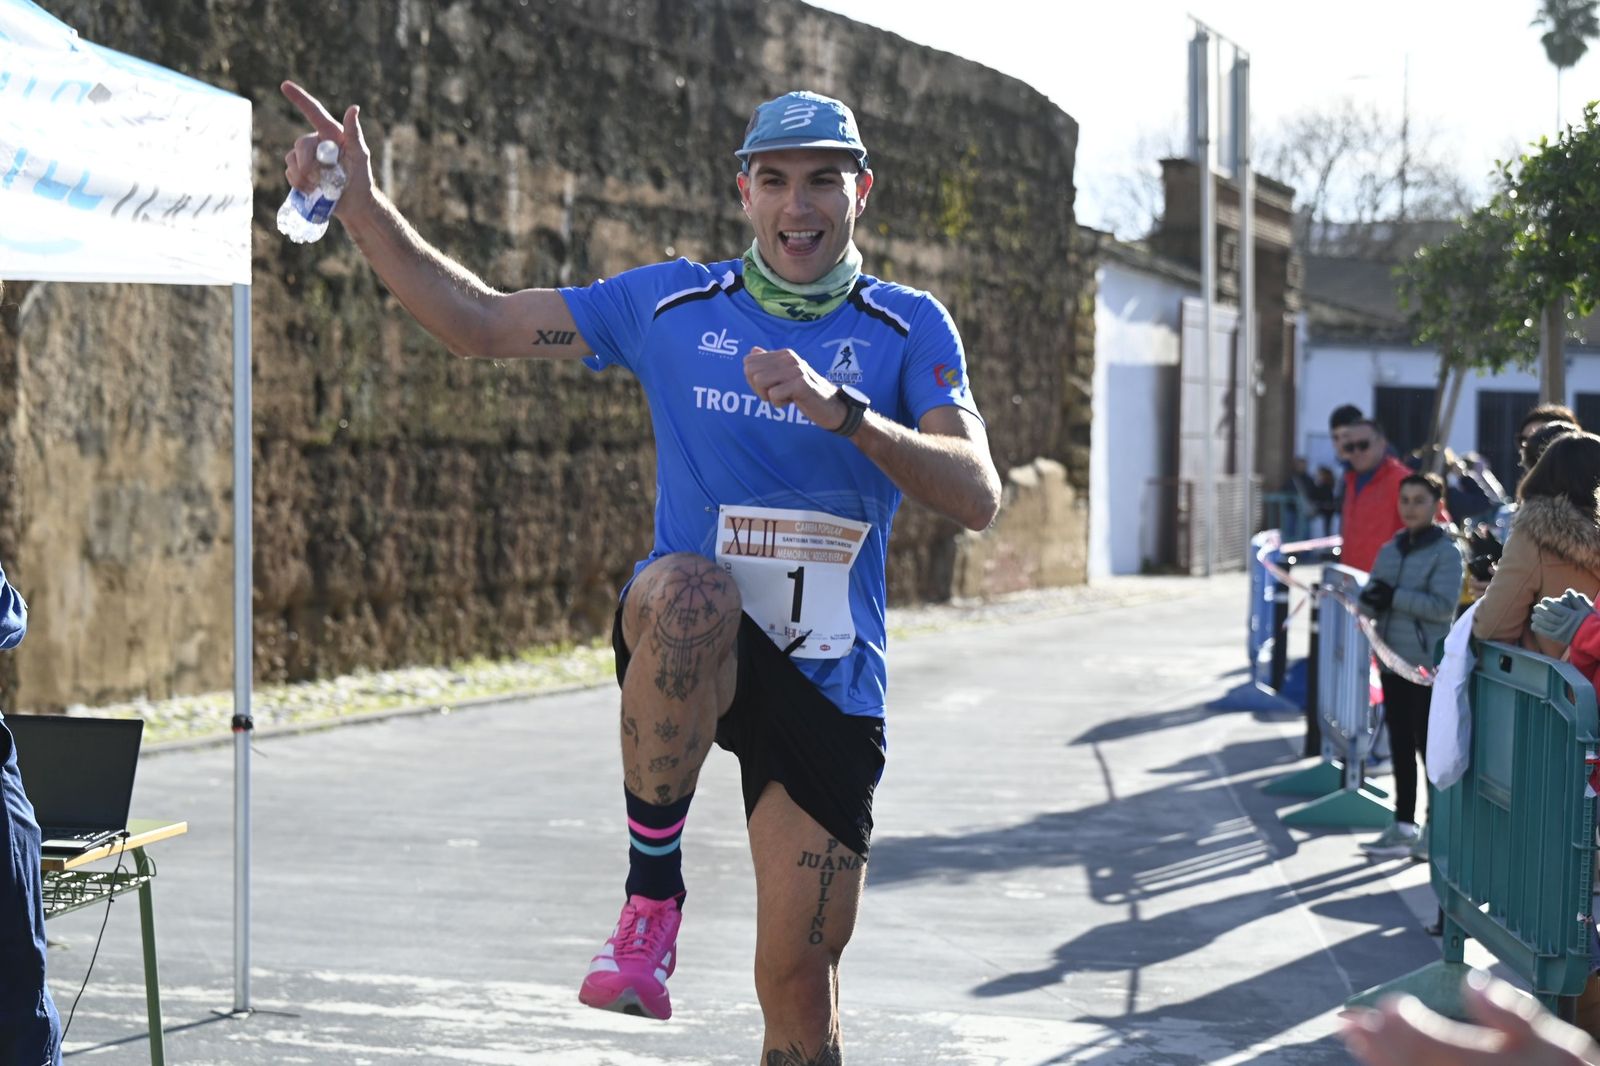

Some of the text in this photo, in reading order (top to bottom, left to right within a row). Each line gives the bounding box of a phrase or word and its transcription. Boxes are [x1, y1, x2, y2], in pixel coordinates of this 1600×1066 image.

[532, 329, 576, 345] XIII
[693, 386, 817, 426] TROTASIE
[725, 516, 778, 558] XLII
[777, 548, 810, 560] MEMORIAL
[787, 566, 804, 623] 1
[797, 851, 861, 870] JUANA
